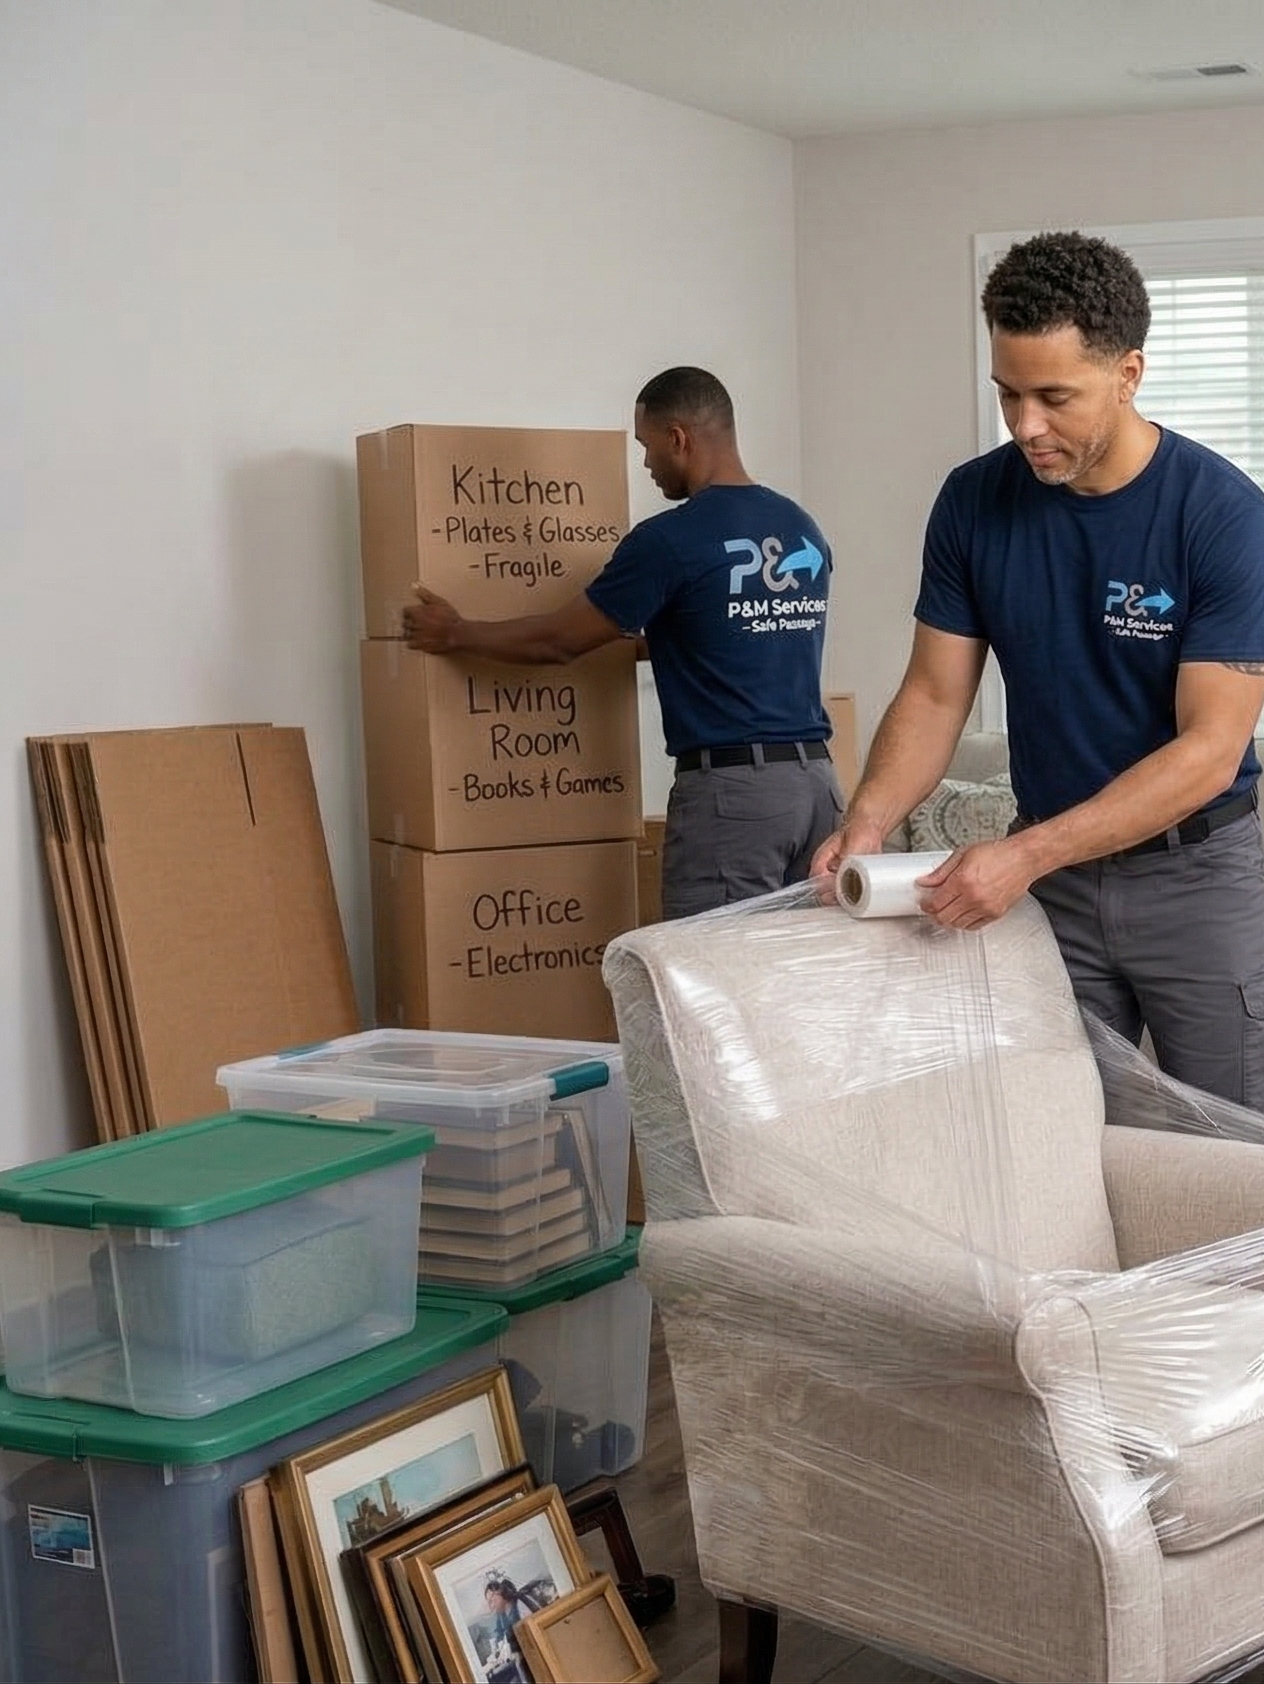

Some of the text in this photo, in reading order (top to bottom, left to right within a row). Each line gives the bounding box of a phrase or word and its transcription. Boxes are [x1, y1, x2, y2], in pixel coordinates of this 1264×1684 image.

[452, 464, 584, 506] Kitchen
[539, 516, 620, 544] Glasses
[728, 596, 827, 618] P&M Services
[467, 675, 576, 726] Living
[490, 723, 580, 760] Room
[556, 767, 625, 796] Games
[473, 889, 585, 931] Office
